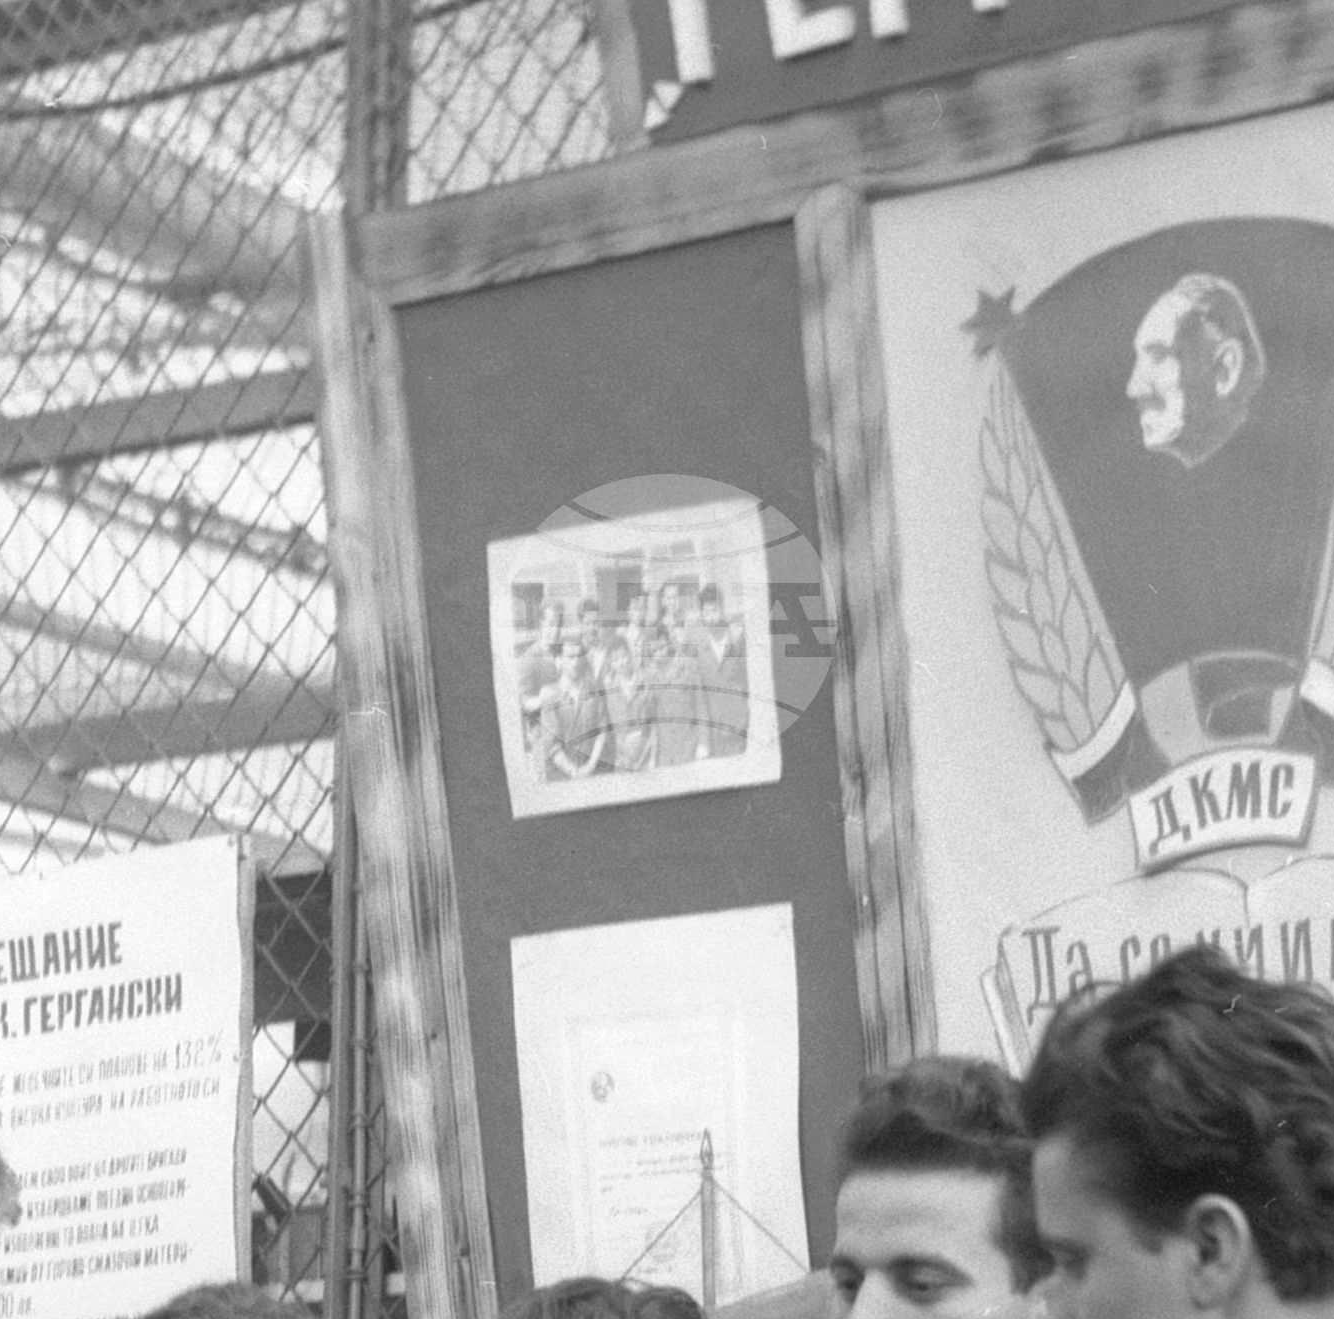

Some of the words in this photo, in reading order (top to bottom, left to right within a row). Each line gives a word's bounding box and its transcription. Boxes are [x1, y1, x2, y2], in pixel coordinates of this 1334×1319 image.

[1147, 760, 1294, 854] ДКМС
[1022, 926, 1095, 1026] Да
[153, 1050, 168, 1072] НА
[110, 1090, 125, 1111] НА
